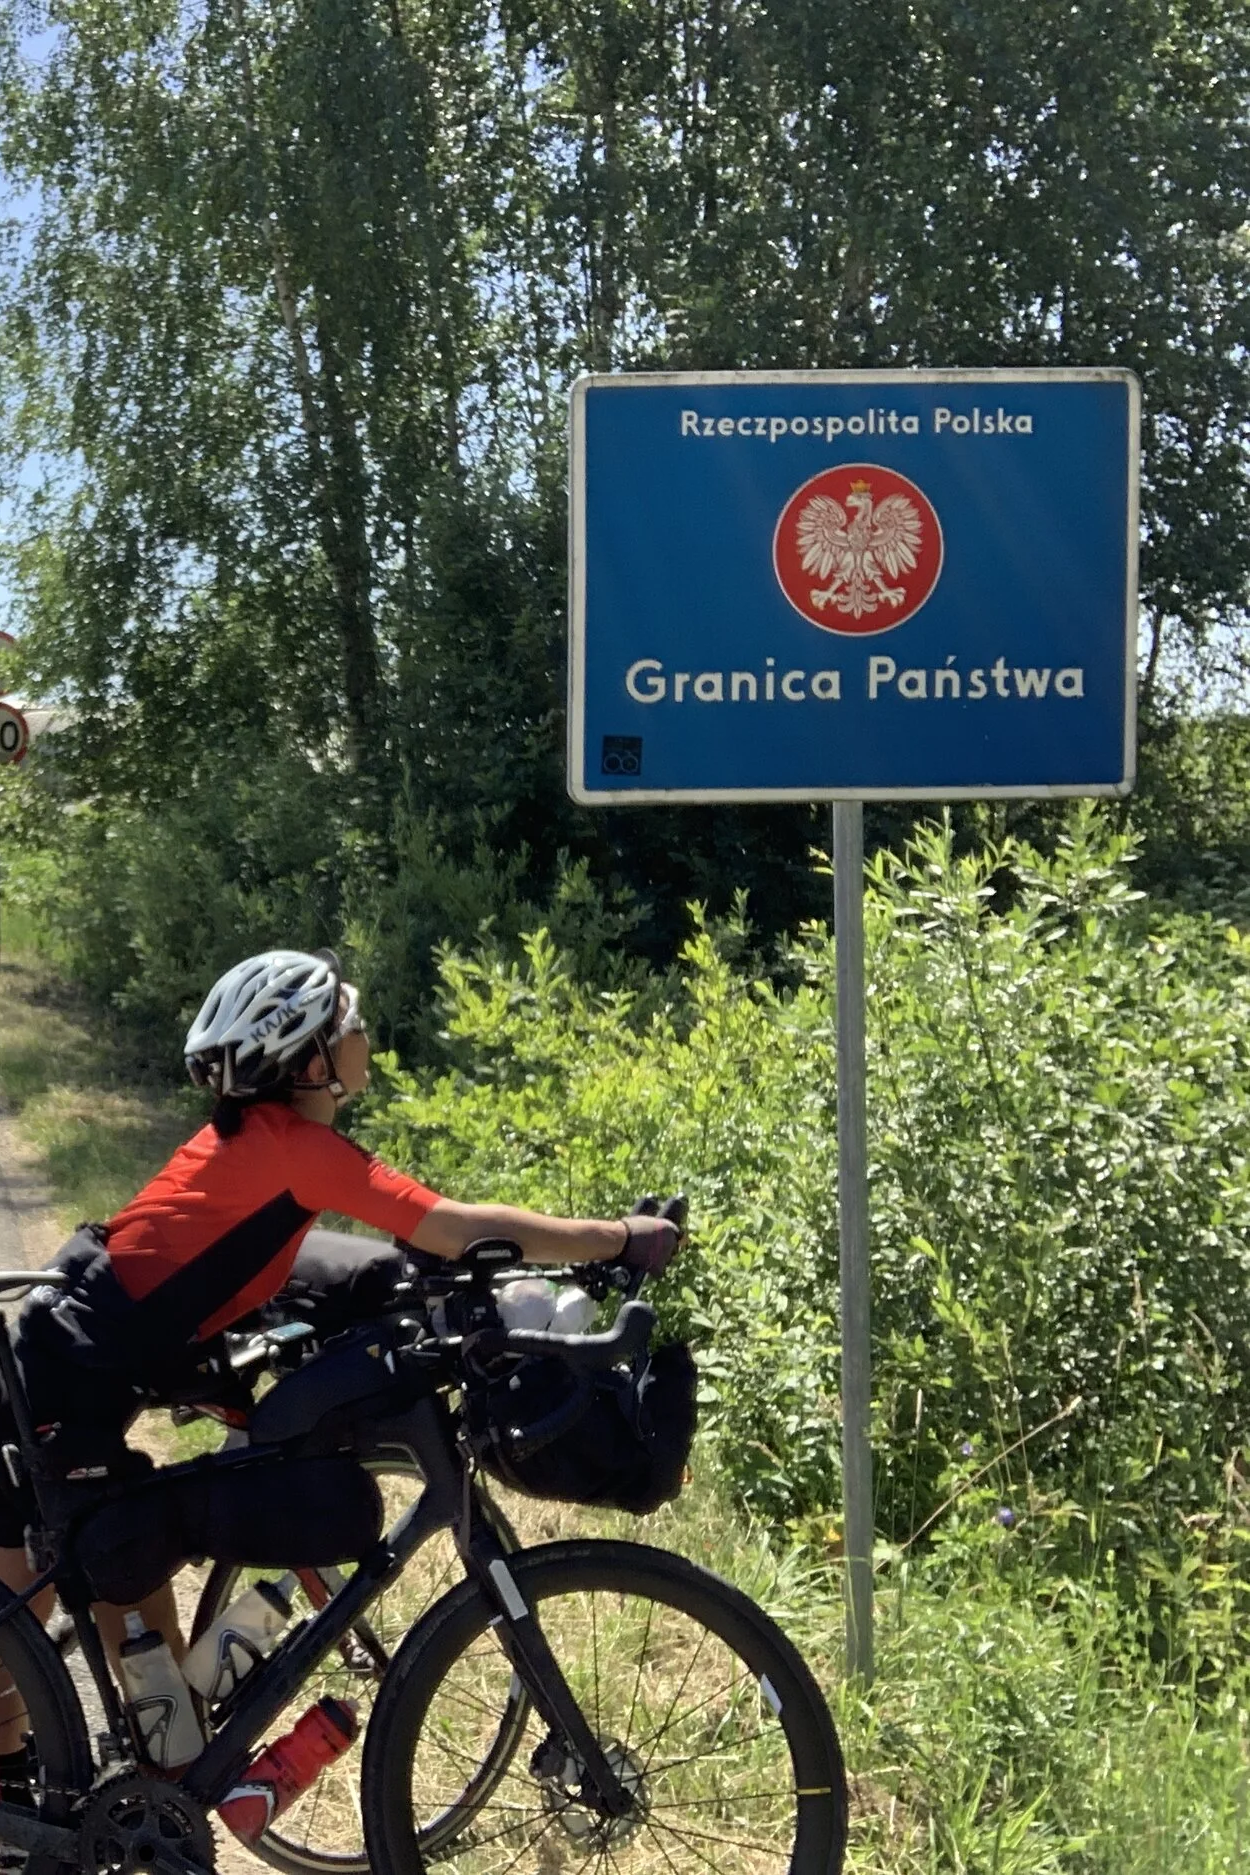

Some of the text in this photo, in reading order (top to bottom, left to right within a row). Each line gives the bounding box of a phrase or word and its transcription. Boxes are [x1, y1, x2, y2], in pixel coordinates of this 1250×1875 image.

[680, 407, 1034, 443] Rzeczpospolita Polska
[625, 655, 1086, 704] Granica Państwa
